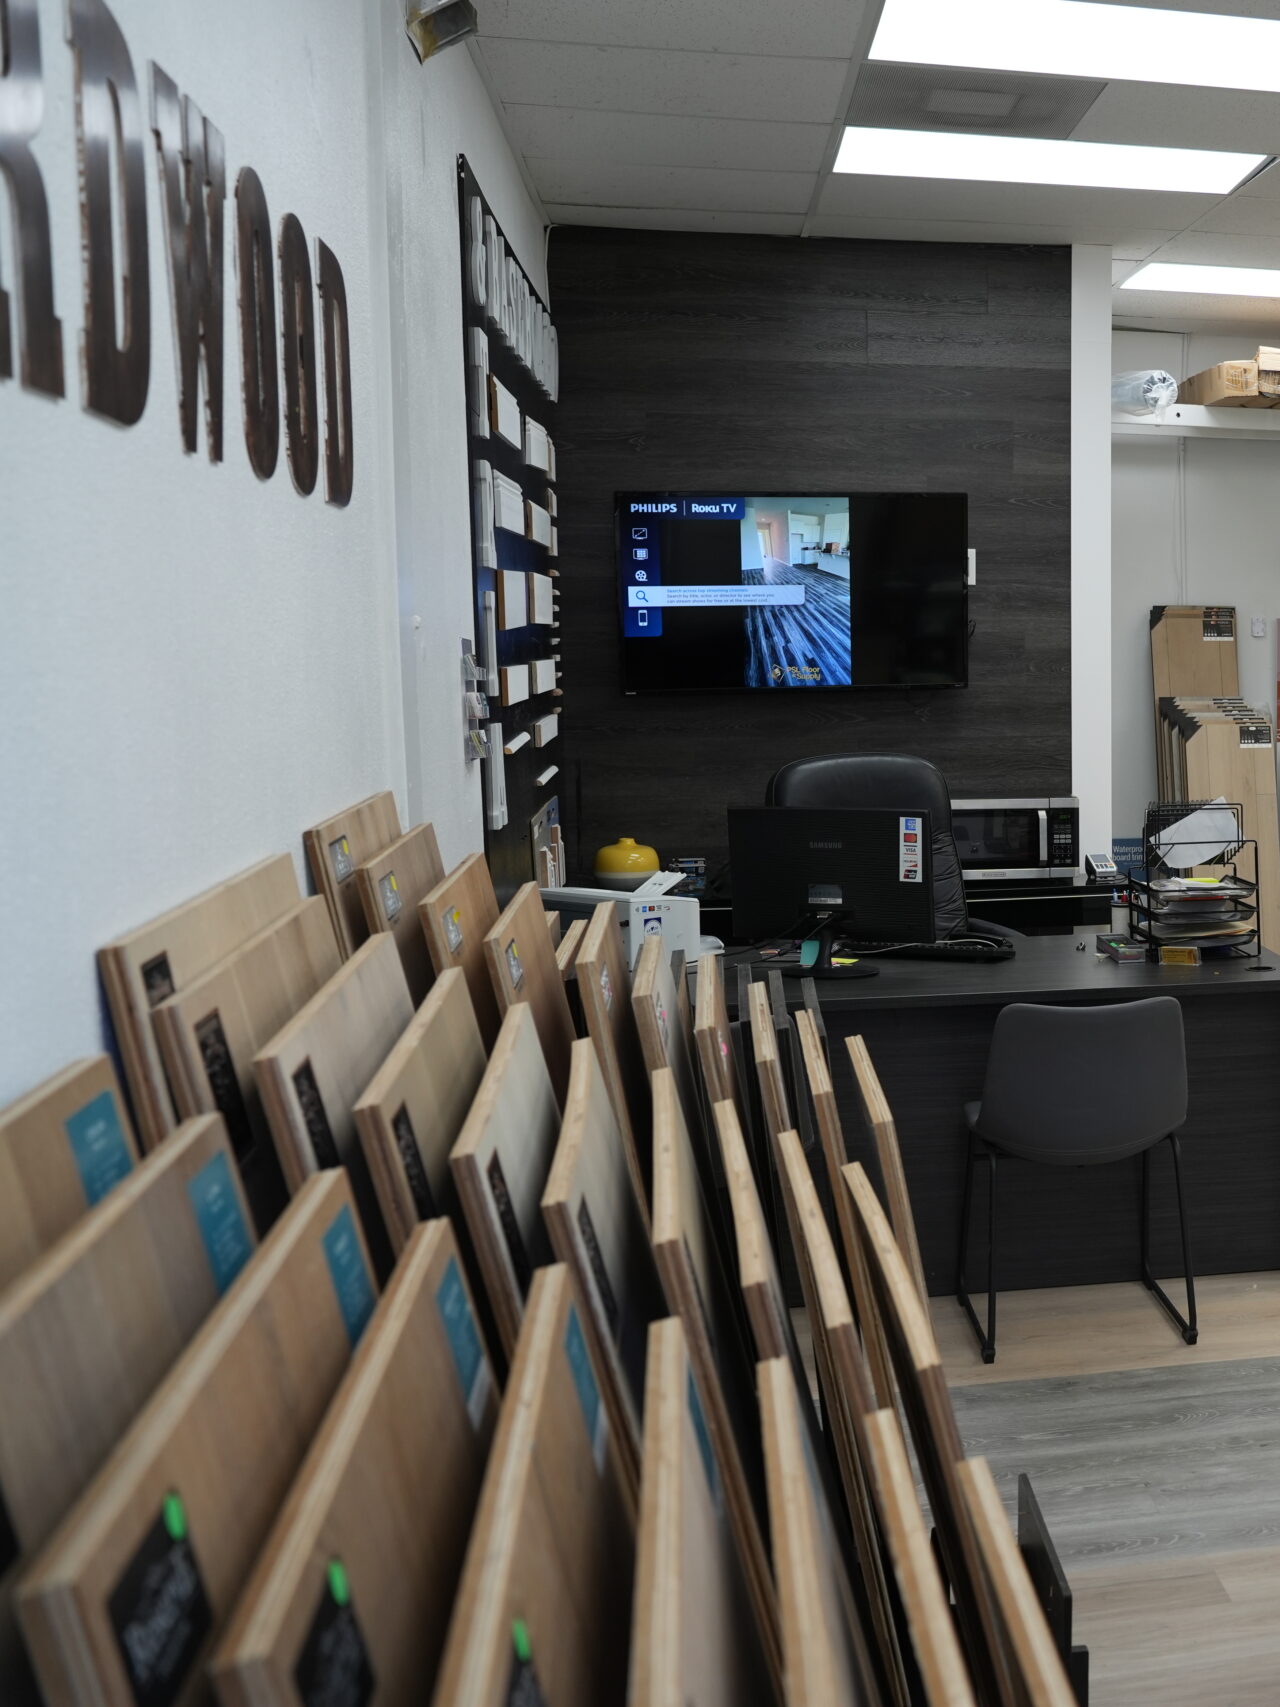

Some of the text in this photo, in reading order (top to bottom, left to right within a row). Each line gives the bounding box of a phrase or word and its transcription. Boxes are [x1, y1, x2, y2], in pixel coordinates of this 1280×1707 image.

[630, 503, 737, 513] PHILIPS Roku TV
[809, 841, 842, 849] SAMSUNG
